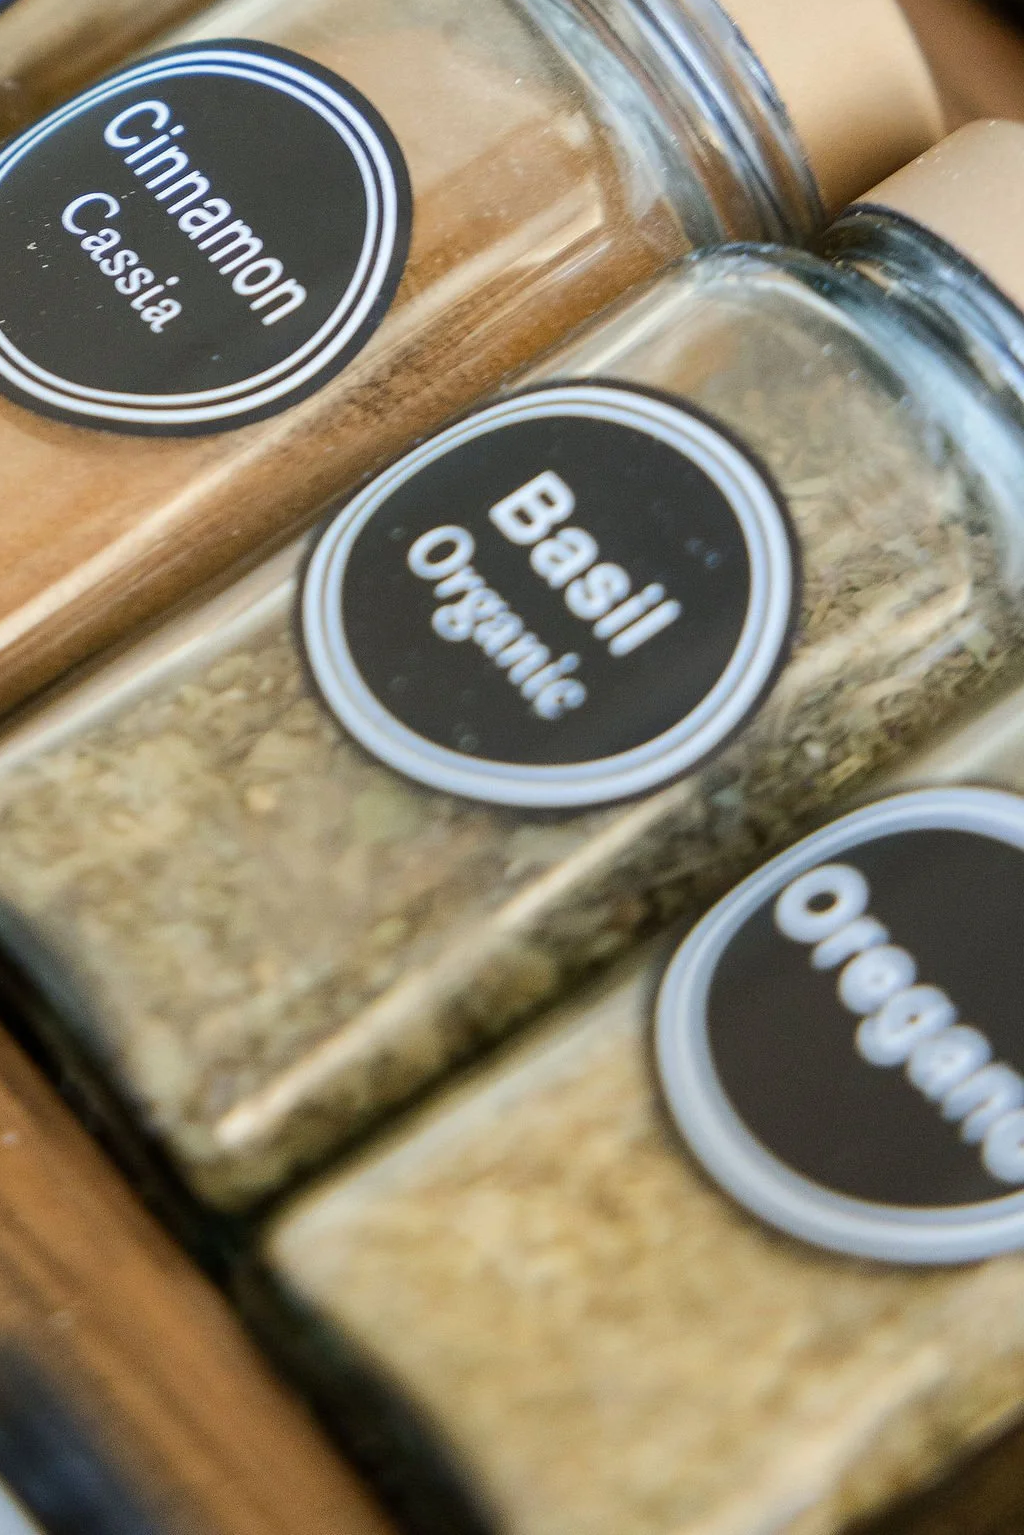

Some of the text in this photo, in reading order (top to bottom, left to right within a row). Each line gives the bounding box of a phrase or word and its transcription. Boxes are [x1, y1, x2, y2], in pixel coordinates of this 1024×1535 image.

[61, 192, 183, 335] Cassia
[103, 99, 308, 327] Cinnamon
[407, 524, 587, 721] Organic
[488, 470, 682, 657] Basil
